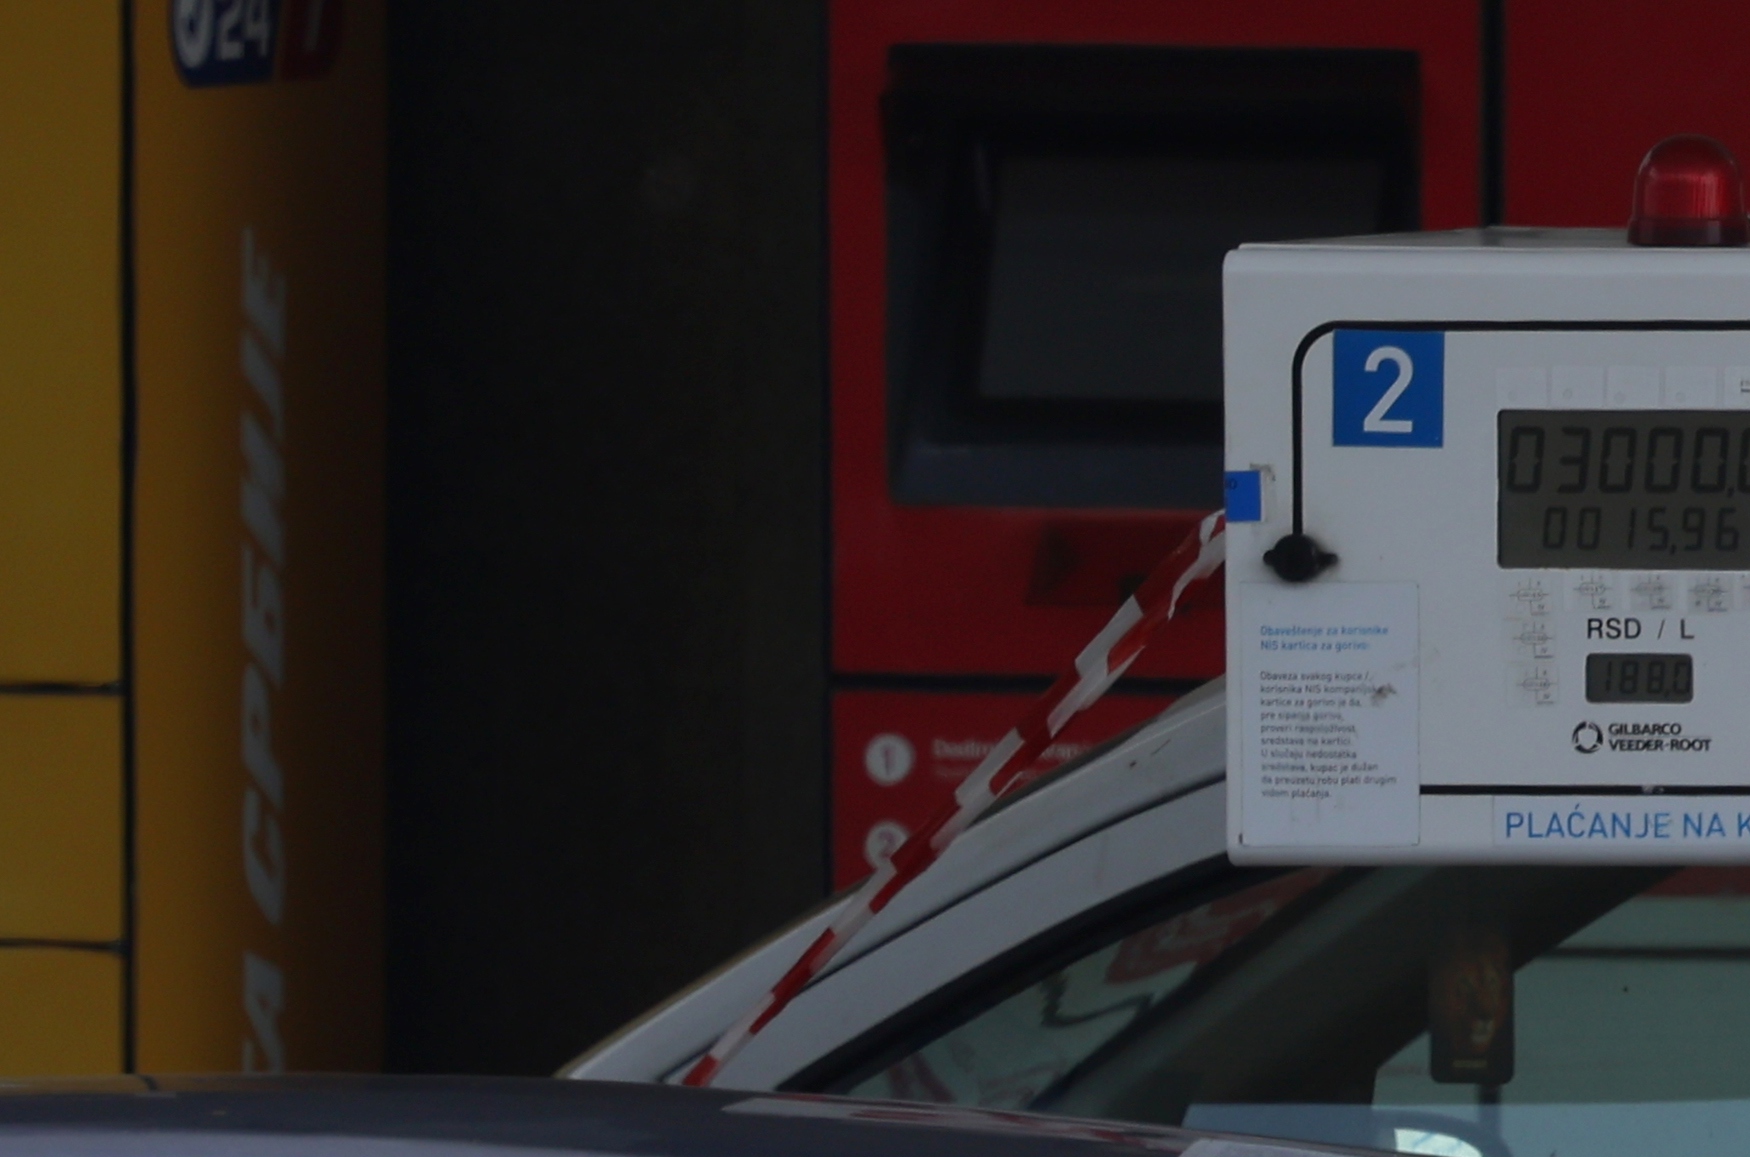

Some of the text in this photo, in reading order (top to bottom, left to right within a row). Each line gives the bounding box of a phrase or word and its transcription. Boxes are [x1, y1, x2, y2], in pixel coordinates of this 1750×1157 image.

[1363, 345, 1414, 433] 2
[1326, 627, 1338, 636] za
[1587, 617, 1642, 640] RSD
[1680, 618, 1695, 639] L
[1260, 640, 1279, 650] NIS
[1281, 640, 1318, 650] kartica
[1321, 642, 1332, 650] za
[1260, 671, 1298, 681] Obaveza
[1305, 684, 1322, 694] NIS
[1608, 722, 1682, 736] GILBARCO
[1608, 738, 1712, 751] VEEDER-ROOT
[1505, 803, 1672, 839] PLAĆANJE
[1682, 812, 1727, 839] NA
